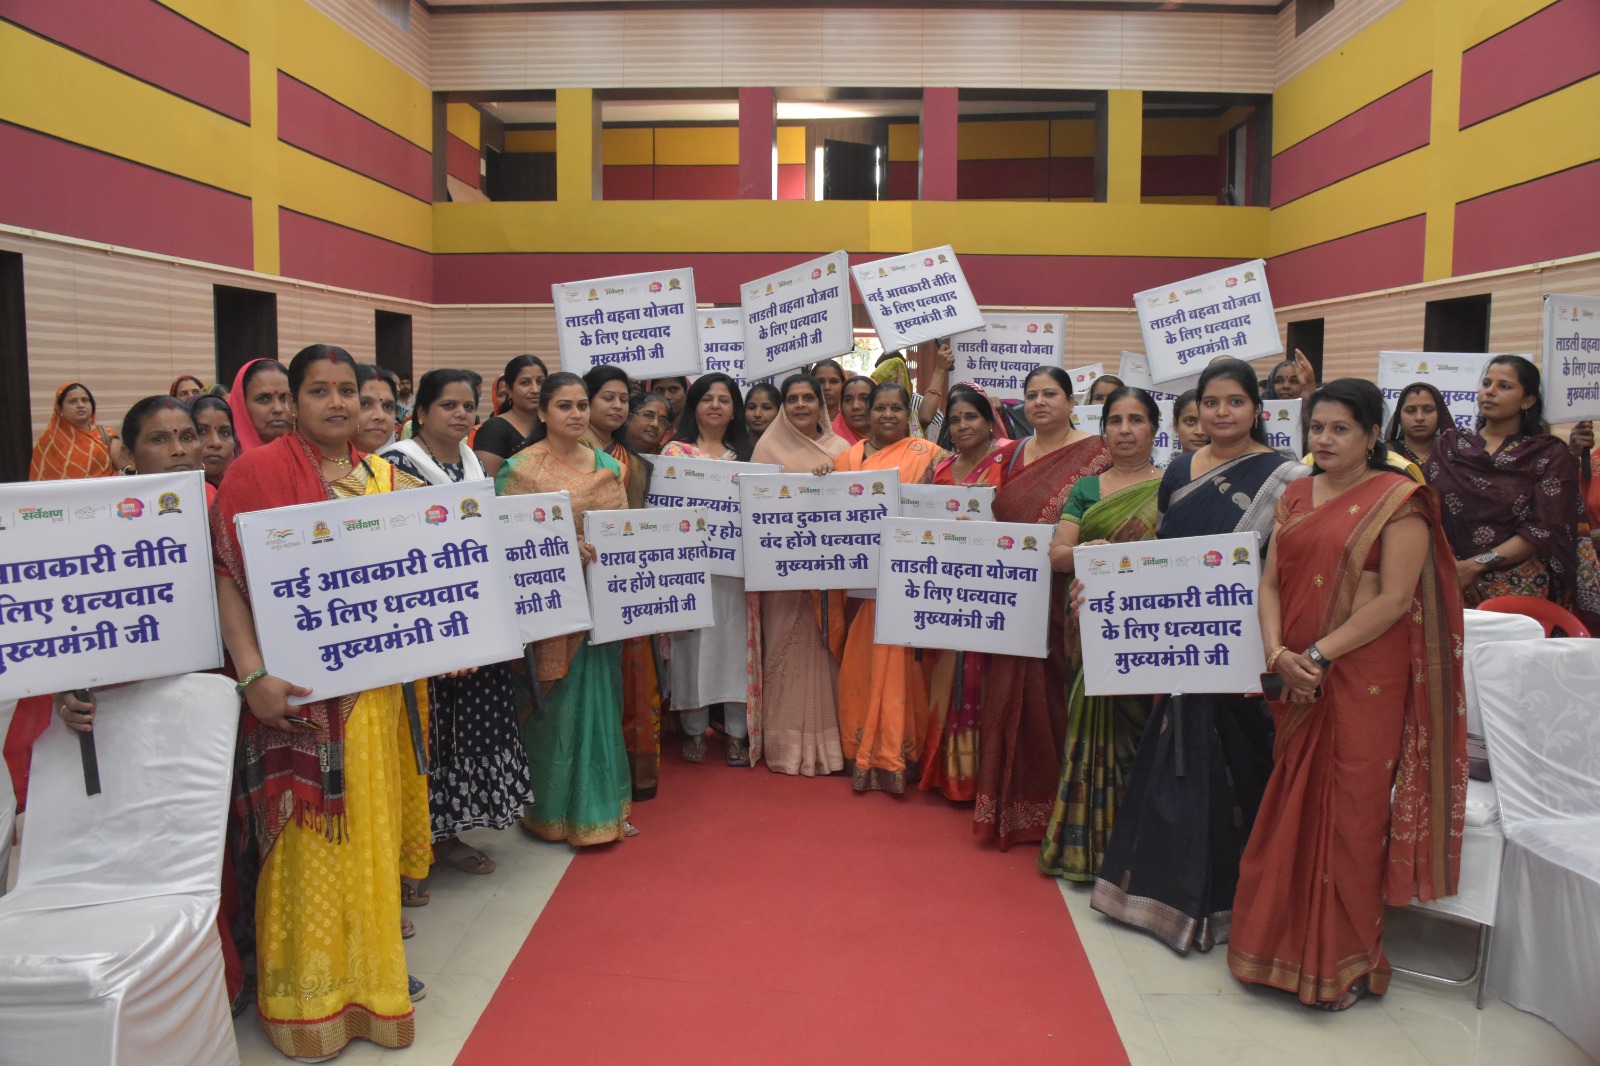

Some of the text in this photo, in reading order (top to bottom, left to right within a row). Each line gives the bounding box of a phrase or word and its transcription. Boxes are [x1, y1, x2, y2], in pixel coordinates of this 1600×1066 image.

[866, 272, 957, 302] नई आबकारी नीति
[565, 302, 684, 327] लाडली बहना योजना
[749, 286, 838, 324] लाडली बहना योजना
[880, 291, 957, 316] के लिए धन्यवाद
[1150, 292, 1261, 330] लाडली बहना योजना
[759, 310, 827, 340] के लिए धन्यवाद
[893, 305, 957, 334] मुख्यमंत्री जी
[1165, 314, 1251, 344] के लिए धन्यवाद
[580, 326, 670, 346] के लिए धन्यवाद
[766, 328, 822, 362] मुख्यमंत्री जी
[958, 339, 1054, 355] लाडली बहना योजना
[1176, 331, 1247, 365] मुख्यमंत्री जी
[1556, 332, 1579, 350] लाडली
[648, 343, 664, 358] जी
[706, 357, 731, 372] लिए
[967, 356, 977, 369] के
[979, 356, 998, 372] लिए
[1563, 358, 1570, 376] के
[1572, 358, 1586, 376] लिए
[1567, 382, 1599, 406] मुख्यमंत्री
[23, 508, 63, 521] सर्वेक्षण
[346, 519, 380, 531] सर्वेक्षण
[752, 503, 888, 528] शराब दुकान अहाते
[122, 537, 187, 568] नीति
[505, 536, 569, 562] कारी नीति
[760, 532, 782, 548] बंद
[785, 530, 817, 550] होंगे
[821, 533, 881, 546] धन्यवाद
[600, 540, 708, 569] शराब दुकान अहाते
[775, 553, 869, 577] मुख्यमंत्री जी
[271, 539, 489, 598] नई आबकारी नीति
[514, 568, 565, 587] धन्यवाद
[891, 555, 1038, 582] लाडली बहना योजना
[607, 571, 705, 593] बंद होंगे धन्यवाद
[905, 579, 1017, 607] के लिए धन्यवाद
[61, 582, 174, 614] धन्यवाद
[294, 580, 479, 631] के लिए धन्यवाद
[514, 589, 562, 615] मंत्री जी
[621, 593, 696, 625] मुख्यमंत्री जी
[1089, 583, 1253, 614] नई आबकारी नीति
[124, 614, 159, 643] जी
[914, 608, 1005, 631] मुख्यमंत्री जी
[1101, 617, 1242, 642] के लिए धन्यवाद
[318, 611, 469, 671] मुख्यमंत्री जी
[1115, 643, 1229, 674] मुख्यमंत्री जी
